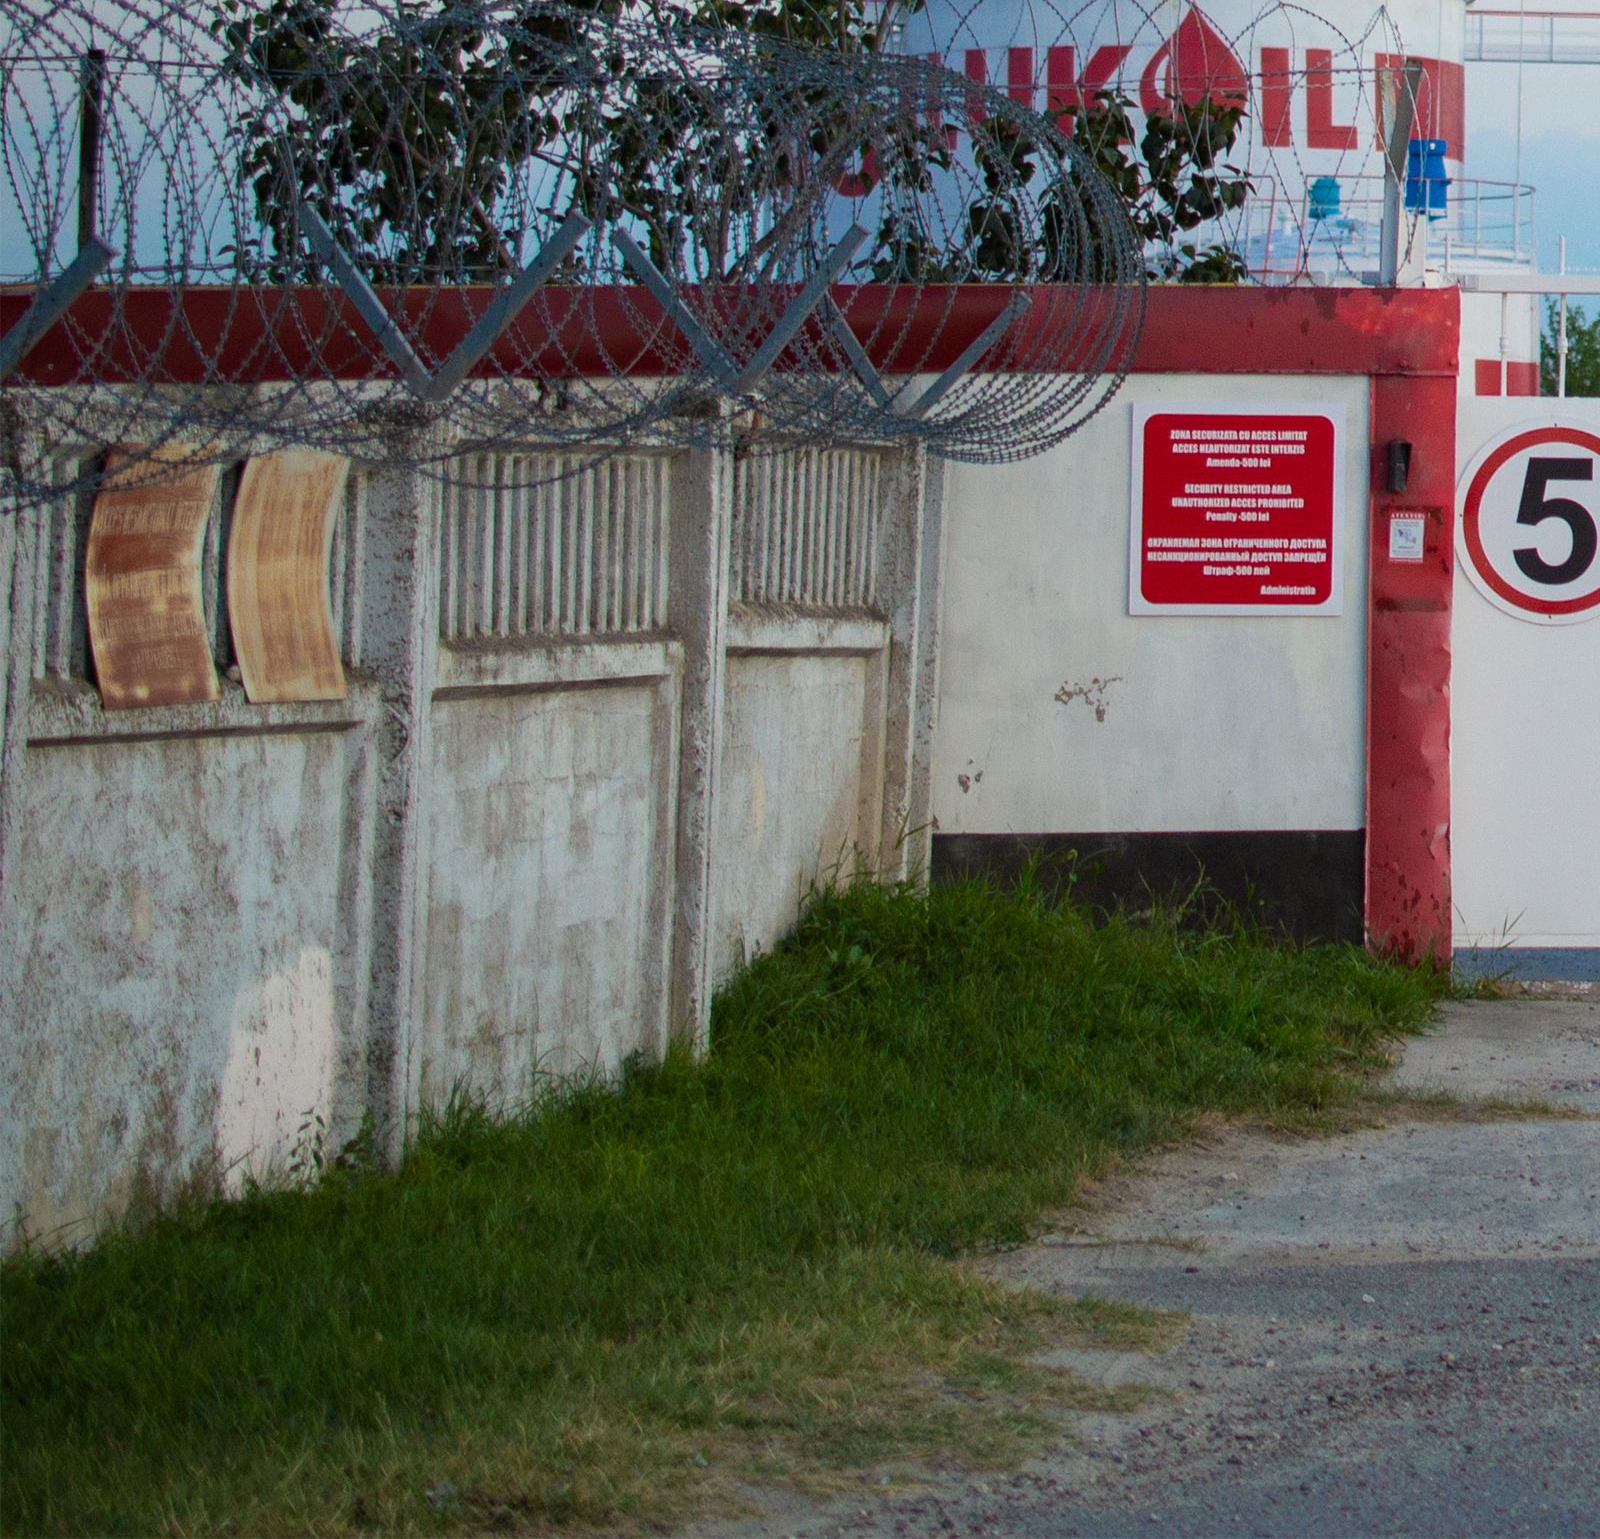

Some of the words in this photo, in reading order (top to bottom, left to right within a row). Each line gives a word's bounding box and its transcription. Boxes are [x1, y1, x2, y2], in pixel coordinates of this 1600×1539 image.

[1170, 429, 1191, 440] ZONA
[1192, 430, 1238, 440] SECURIZATA
[1239, 430, 1251, 441] CU
[1251, 430, 1276, 441] ACCES
[1278, 430, 1308, 441] LIMITAT
[1172, 443, 1198, 454] ACCES
[1200, 443, 1250, 454] NEAUTORIZAT
[1252, 444, 1270, 454] ESTE
[1271, 444, 1305, 455] INTERZIS
[1185, 483, 1222, 494] SECURITY
[1224, 484, 1271, 494] RESTRICTED
[1271, 484, 1292, 495] AREA
[1172, 497, 1230, 508] UNAUTHORIZED
[1231, 498, 1256, 508] ACCES
[1258, 498, 1304, 509] PROHIBITED
[1206, 511, 1237, 523] Penalty
[1513, 457, 1598, 586] 5
[1147, 537, 1200, 548] ОХРАНЯЕМАЯ
[1201, 537, 1222, 548] ЗОНА
[1223, 537, 1288, 548] ОГРАНИЧЕННОГО
[1289, 538, 1327, 549] ДОСТУПА
[1251, 552, 1283, 563] ДОСТУП
